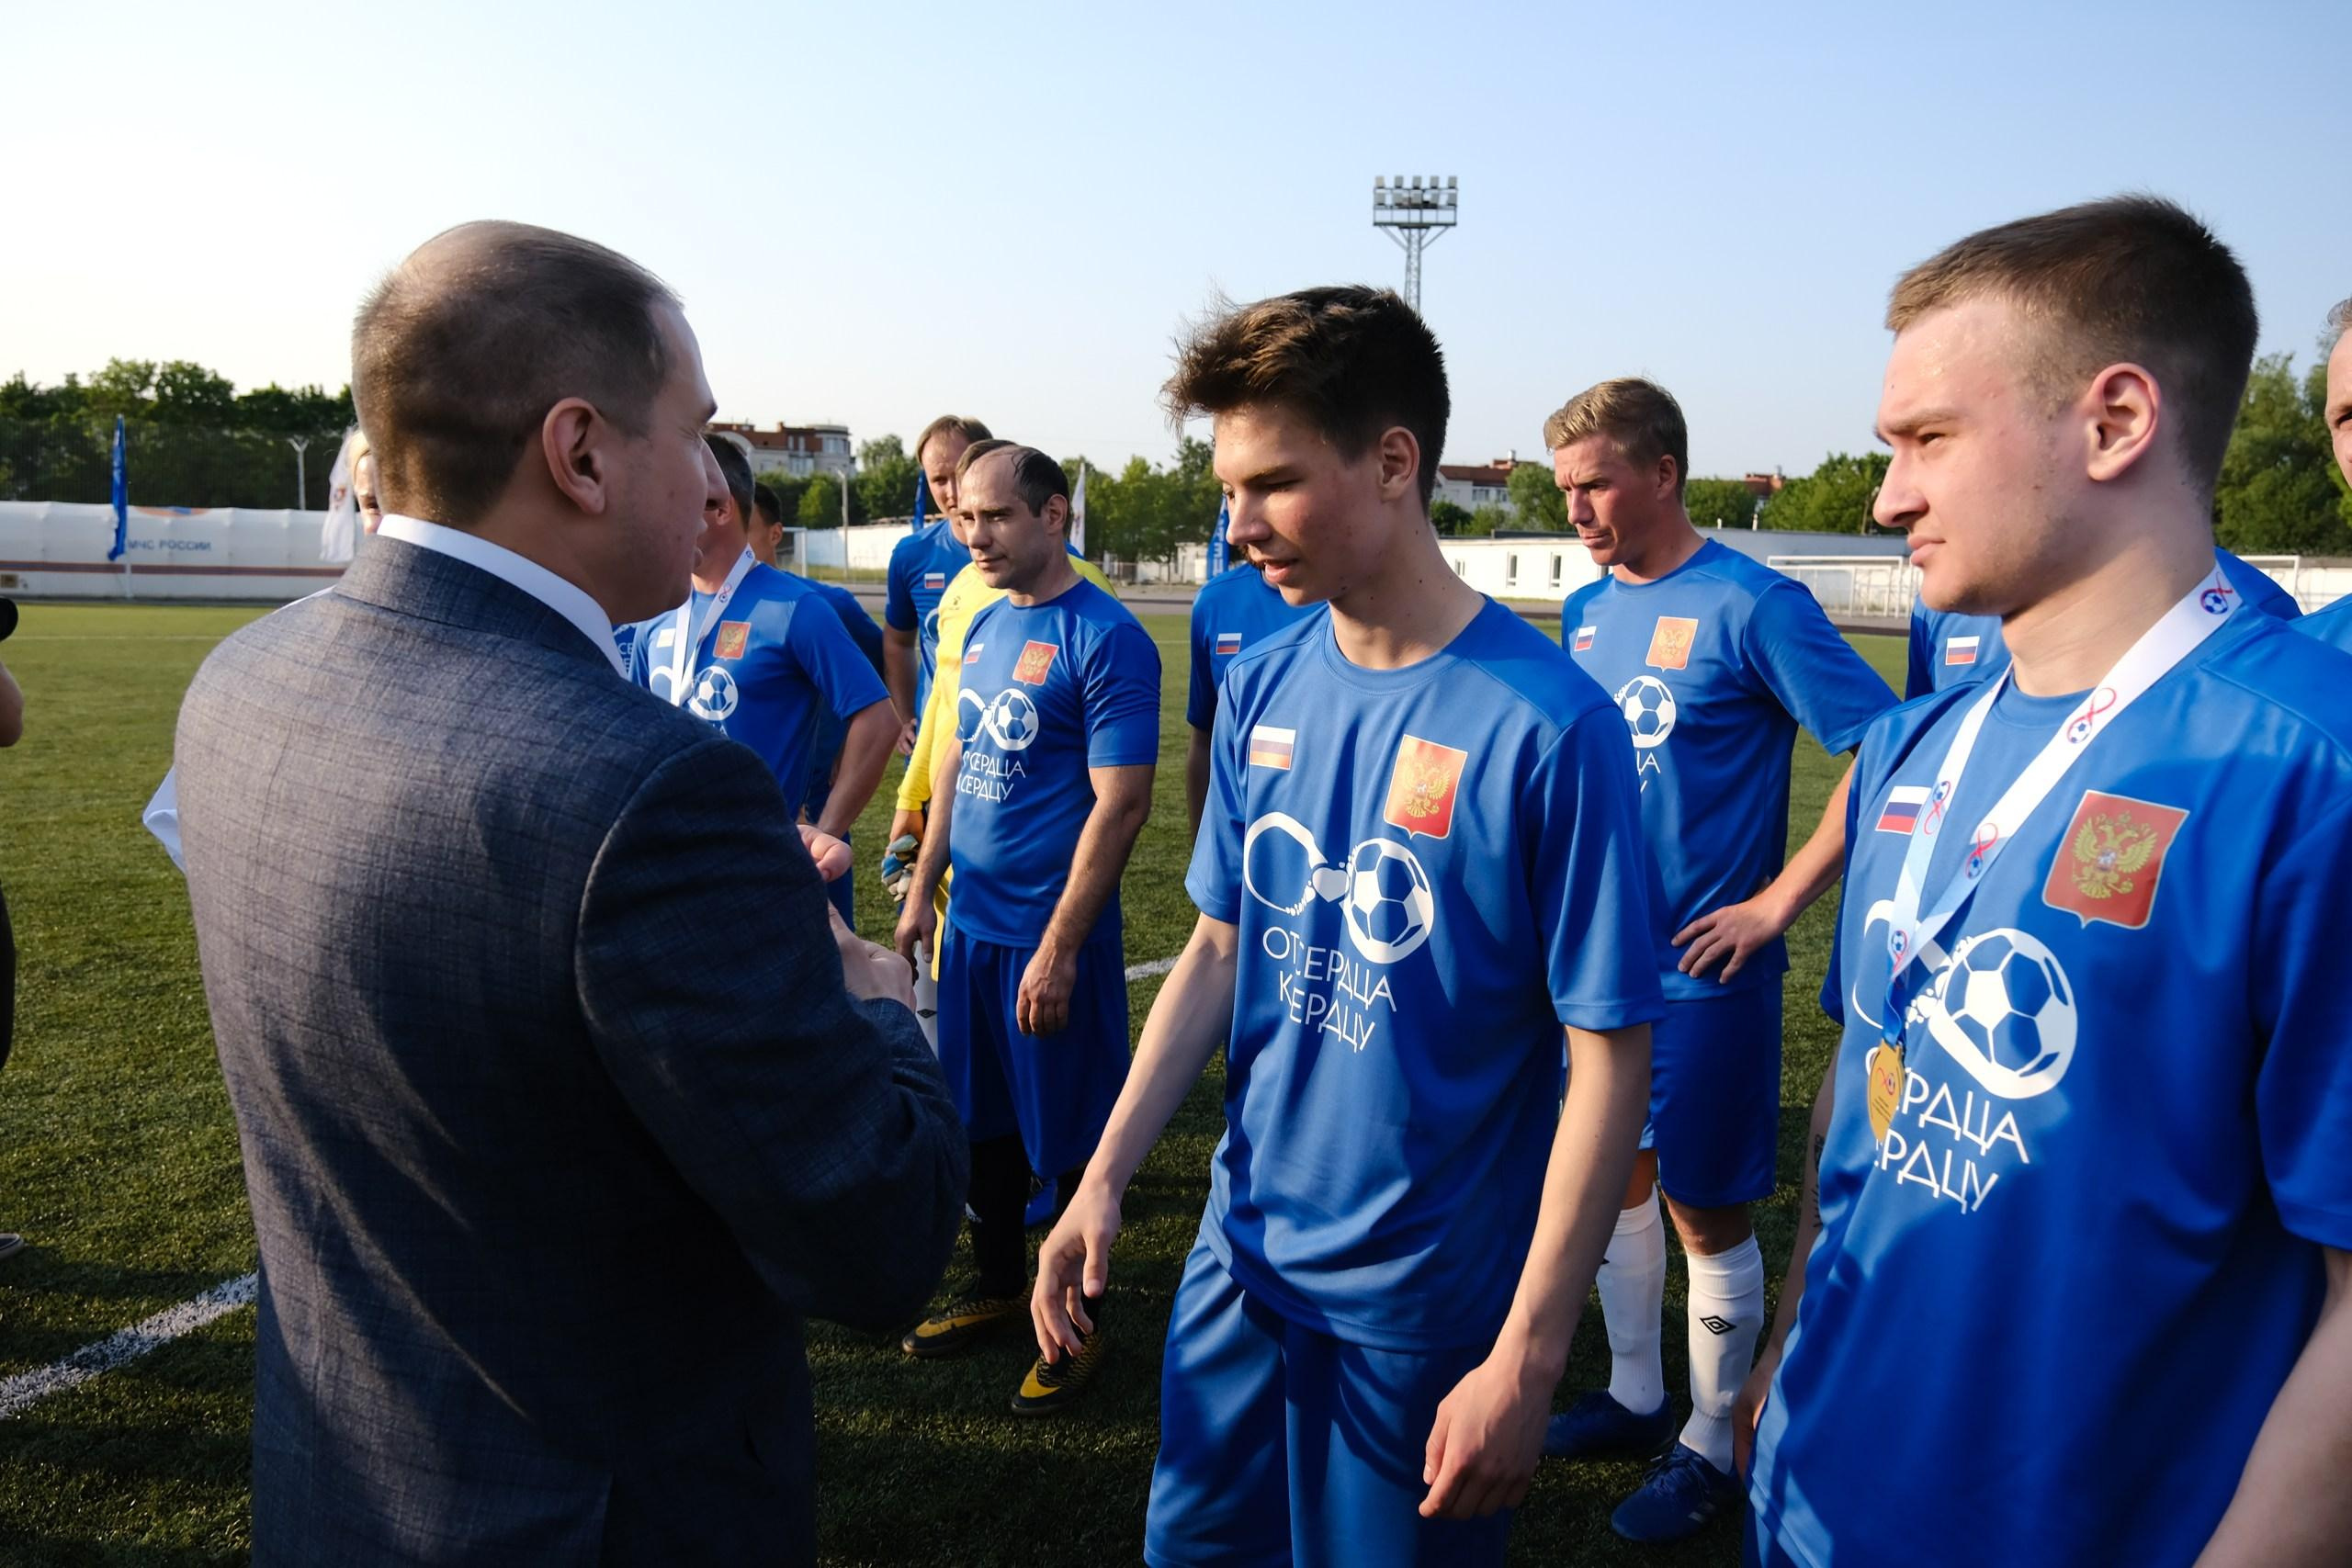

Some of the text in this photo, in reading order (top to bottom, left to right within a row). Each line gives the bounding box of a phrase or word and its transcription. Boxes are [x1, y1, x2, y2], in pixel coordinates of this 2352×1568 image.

[159, 539, 211, 552] РОССИИ
[969, 751, 1026, 781] СЕРДЦА
[960, 774, 1014, 804] СЕРДЦУ
[1262, 926, 1301, 964] ОТ
[1279, 970, 1375, 1054] К ЕРДЦУ
[1895, 1066, 2030, 1164] РДЦА
[1873, 1127, 1999, 1214] РДЦУ
